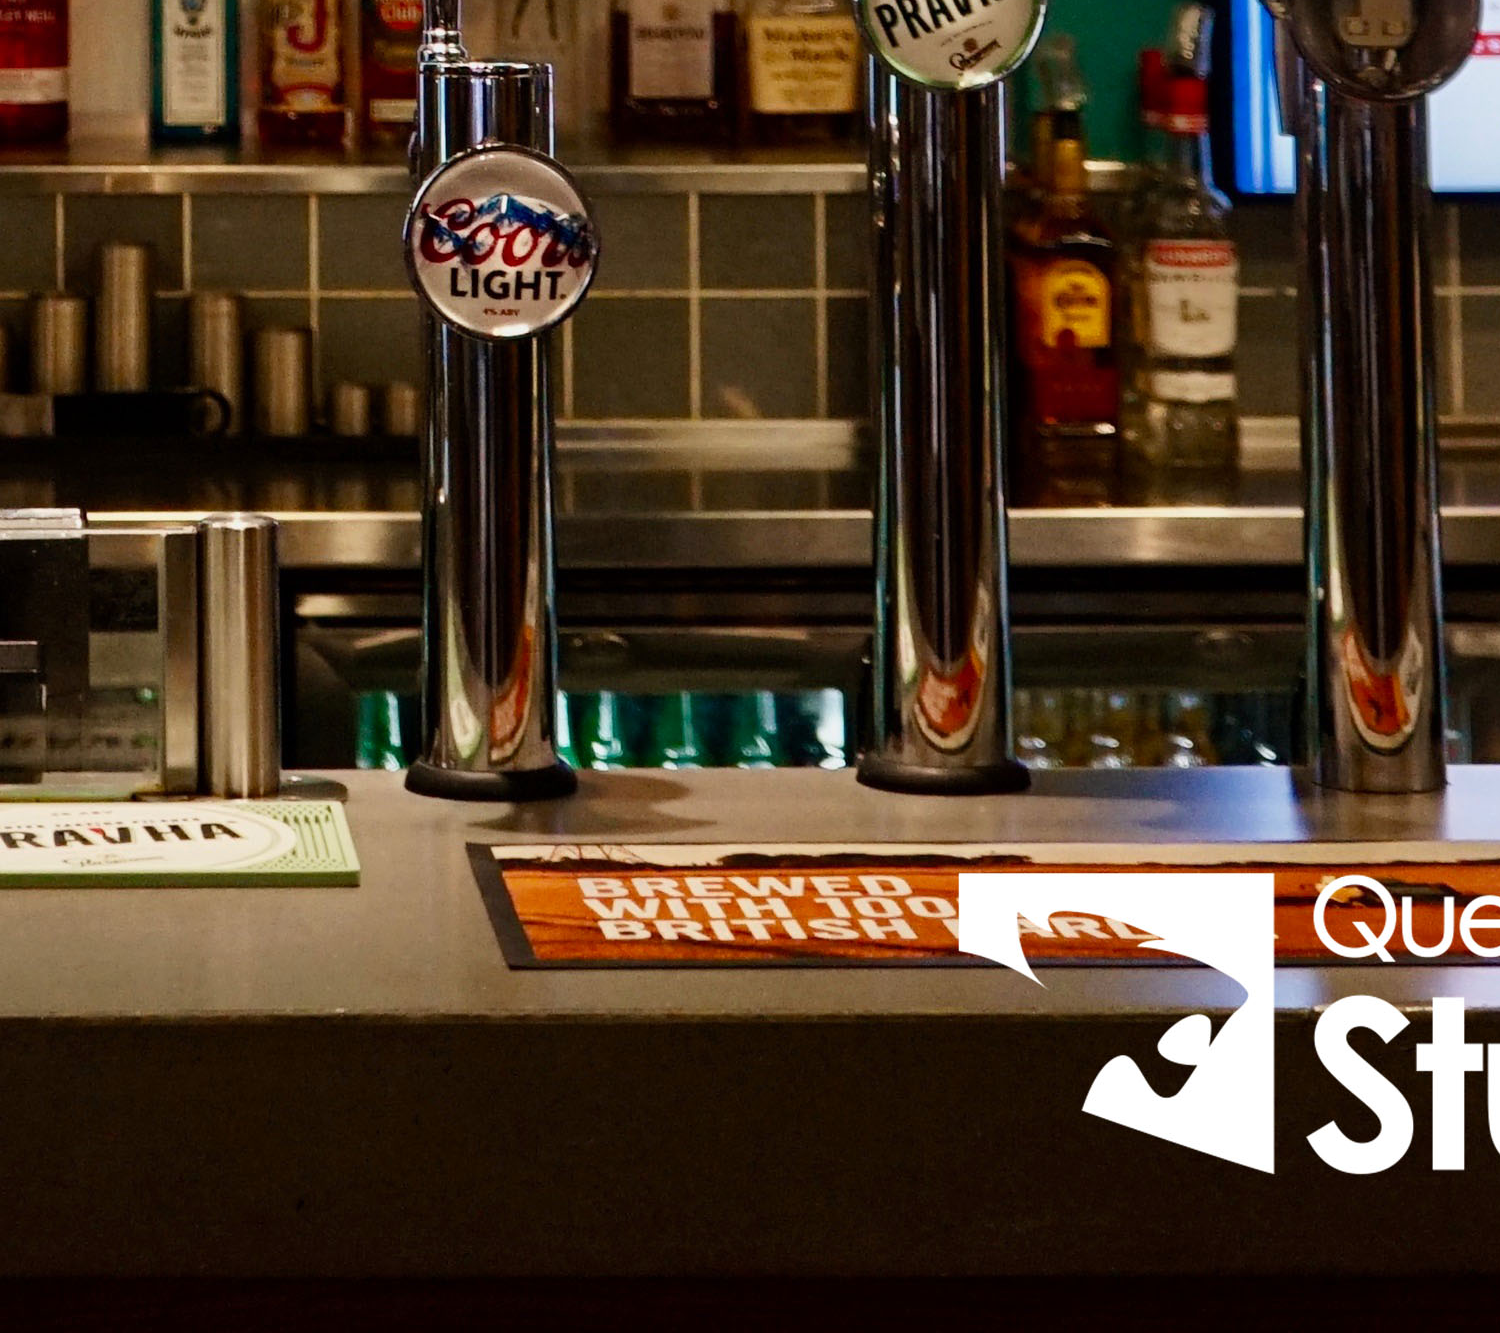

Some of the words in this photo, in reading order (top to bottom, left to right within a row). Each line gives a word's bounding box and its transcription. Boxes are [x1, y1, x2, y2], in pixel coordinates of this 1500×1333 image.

[450, 267, 563, 301] LIGHT
[577, 875, 913, 899] BREWED
[583, 896, 794, 920] WITH
[813, 895, 959, 919] 100
[598, 919, 919, 942] BRITISH
